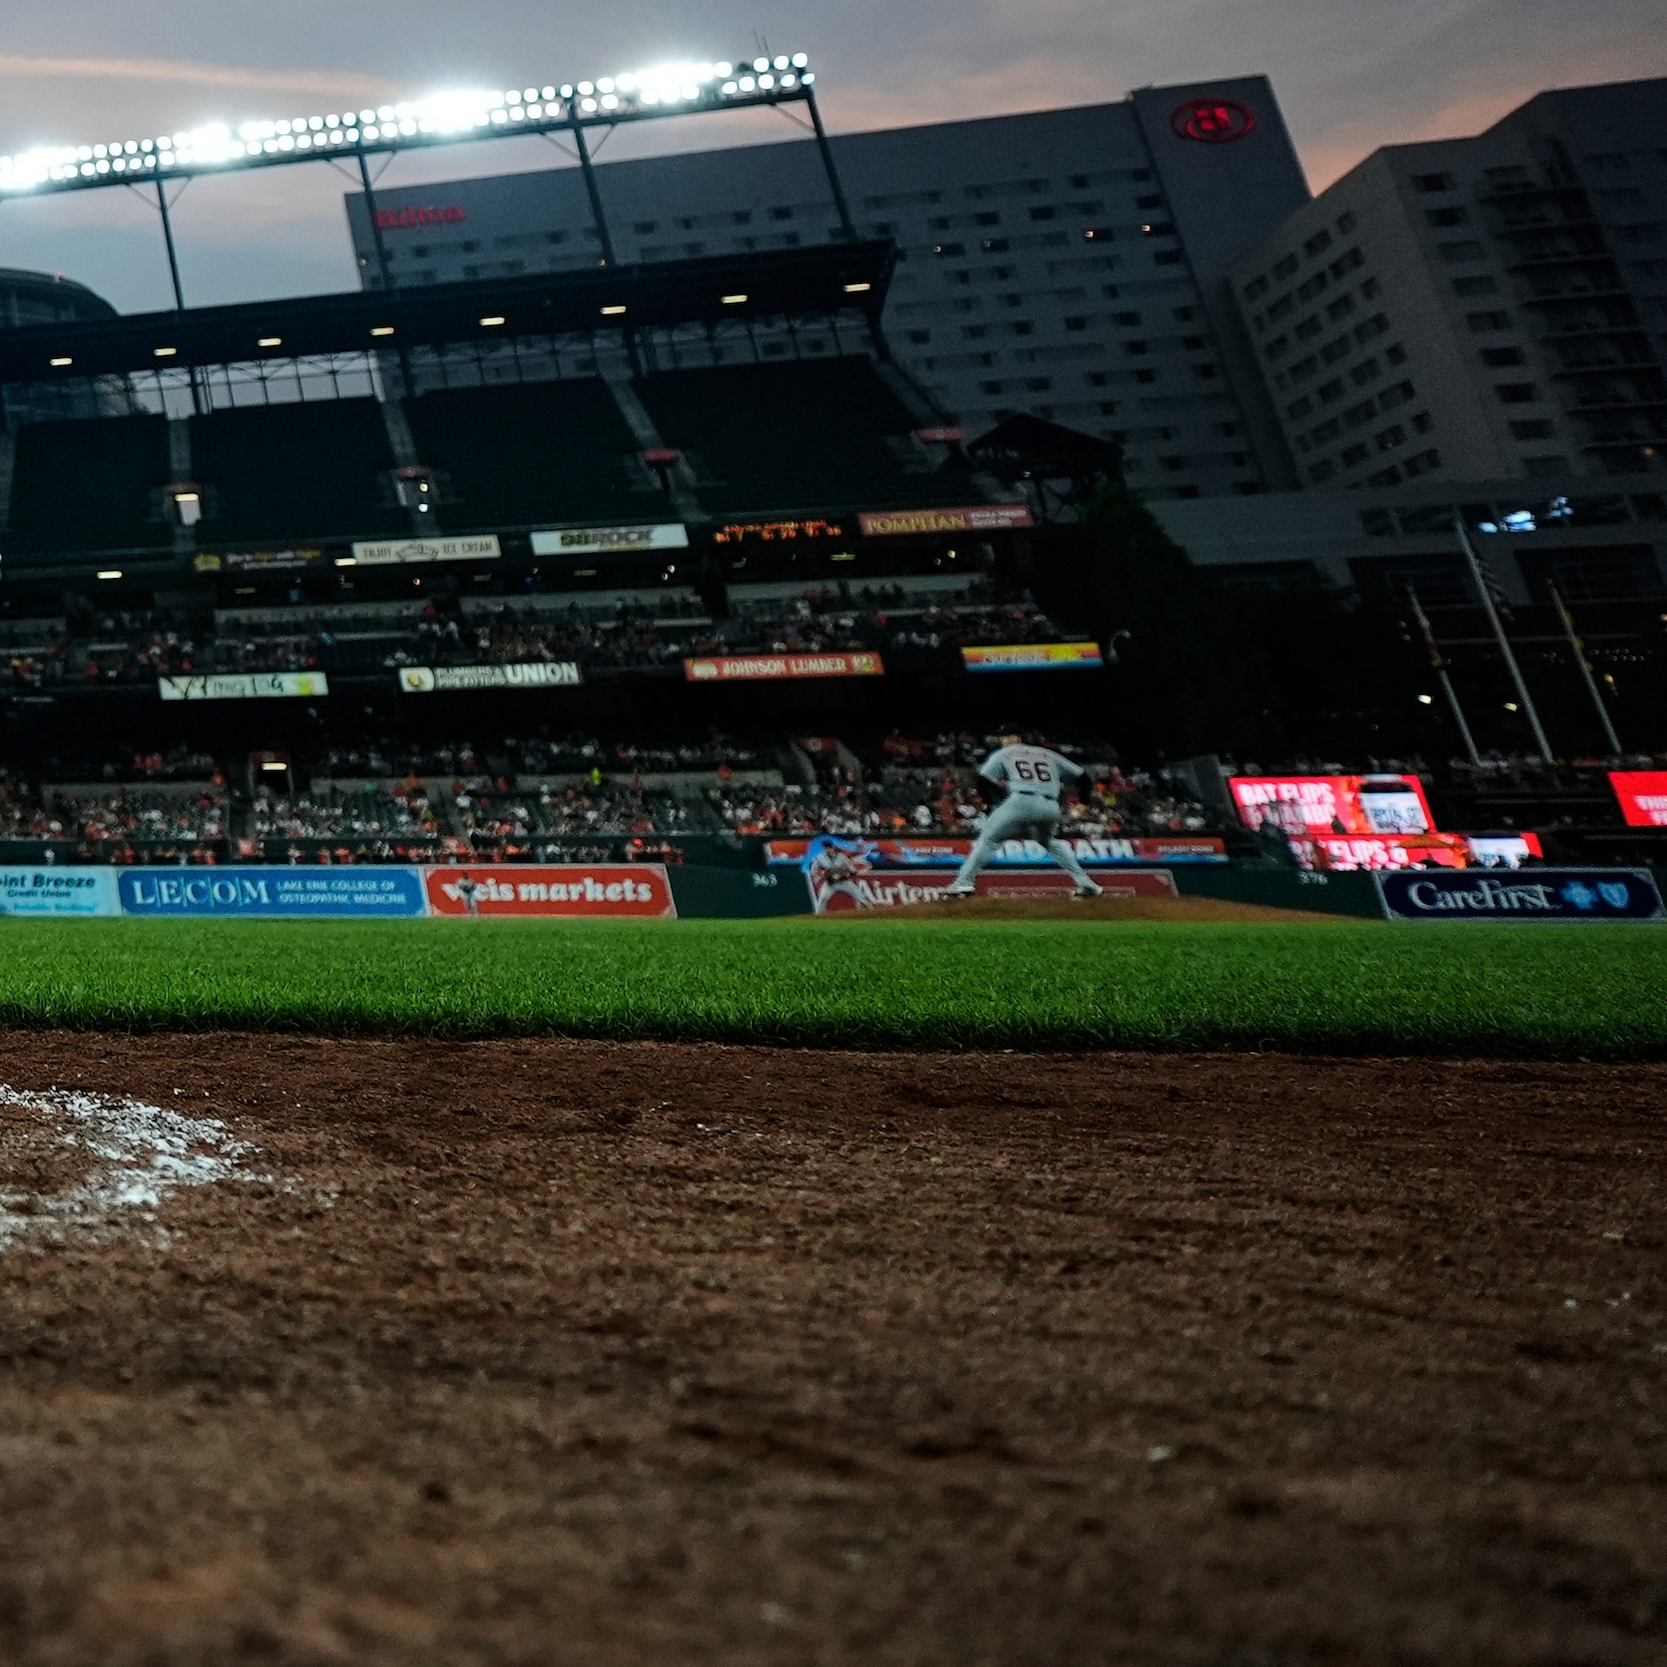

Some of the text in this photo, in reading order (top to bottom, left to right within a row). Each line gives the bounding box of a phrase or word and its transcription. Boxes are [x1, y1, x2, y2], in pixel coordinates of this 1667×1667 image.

[375, 205, 466, 230] Hilton
[505, 663, 578, 684] UNION
[723, 659, 787, 675] JOHNSON
[790, 656, 848, 672] LUMBER
[1015, 760, 1051, 781] 66
[33, 873, 96, 888] Breeze
[517, 877, 653, 903] markets
[1408, 880, 1563, 912] CareFirst
